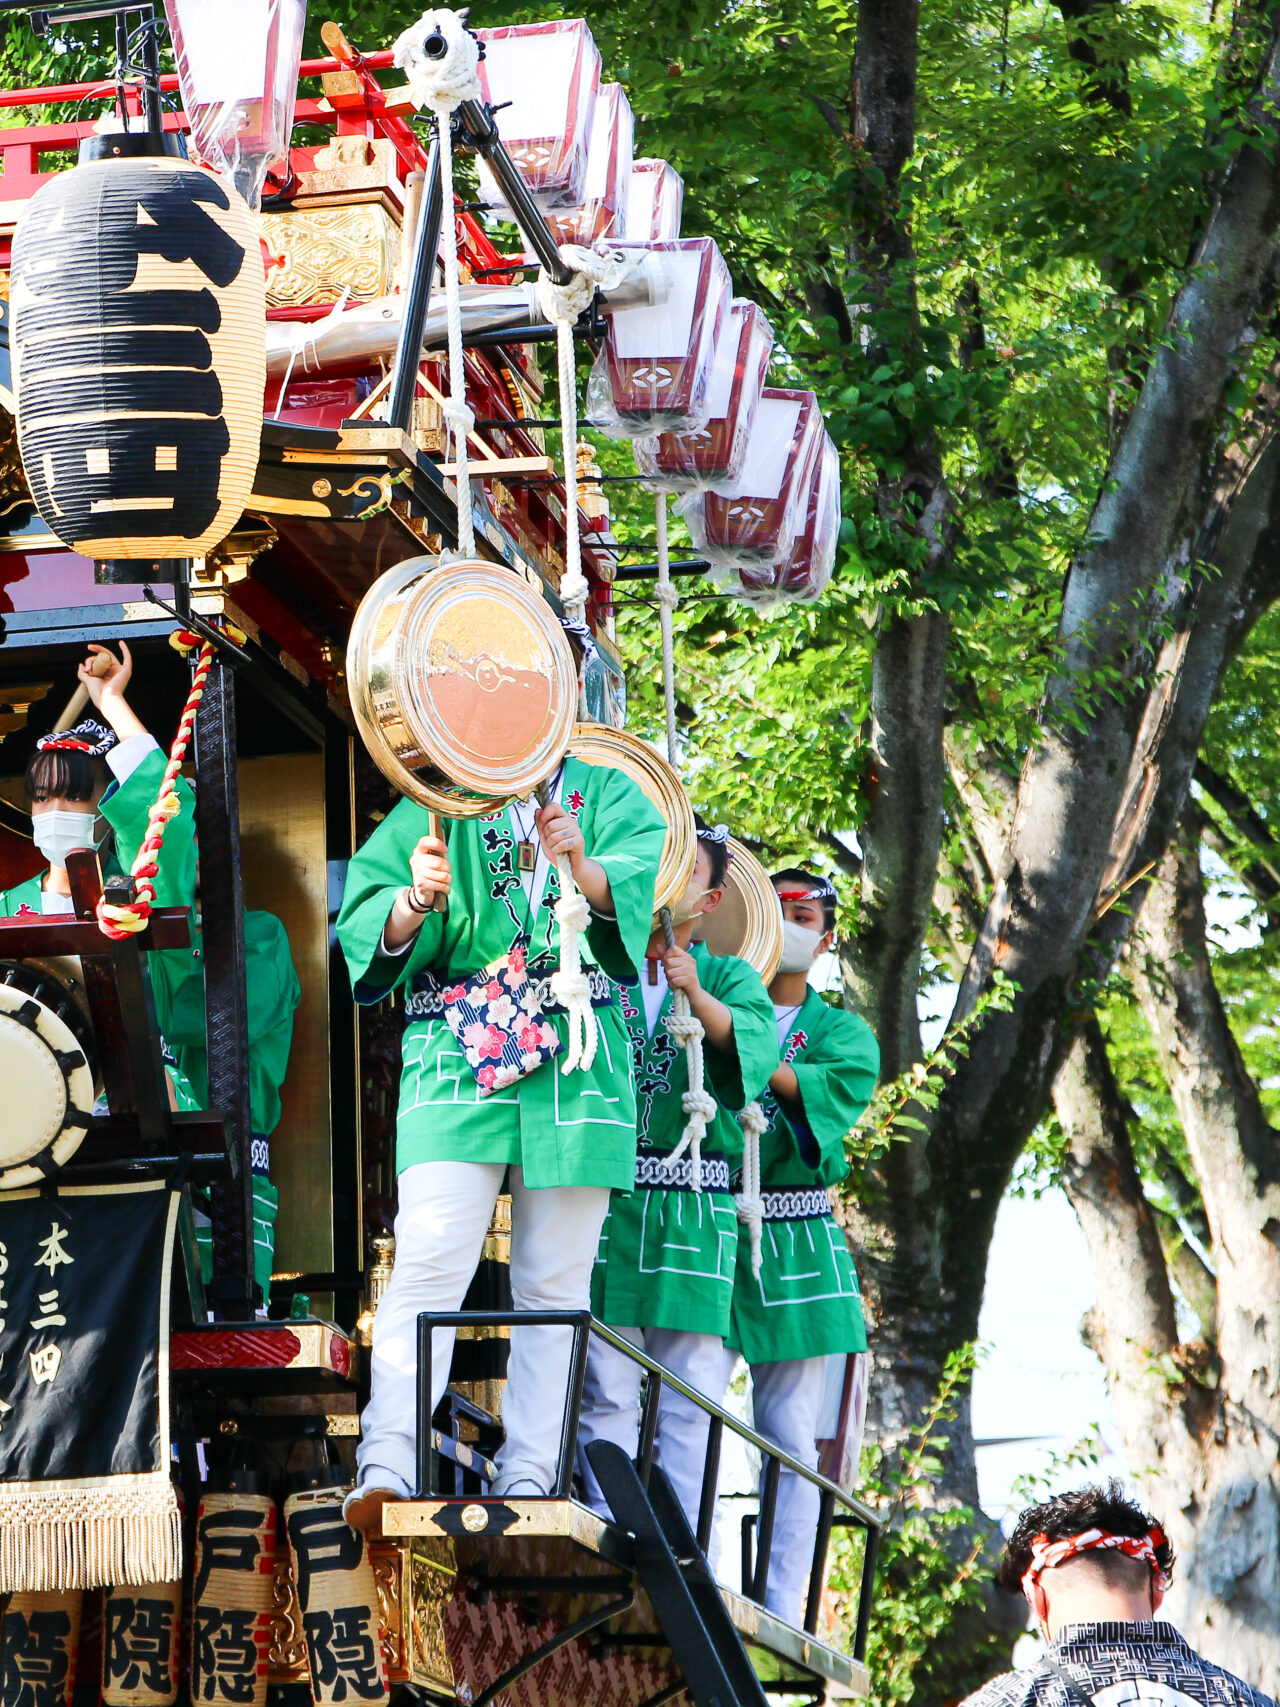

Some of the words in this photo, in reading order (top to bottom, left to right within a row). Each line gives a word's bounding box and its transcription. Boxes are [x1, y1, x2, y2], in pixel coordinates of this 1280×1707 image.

[29, 1221, 76, 1386] 本三四
[102, 1586, 176, 1694] 隠
[192, 1509, 266, 1704] 戸隠
[288, 1505, 387, 1704] 戸隠
